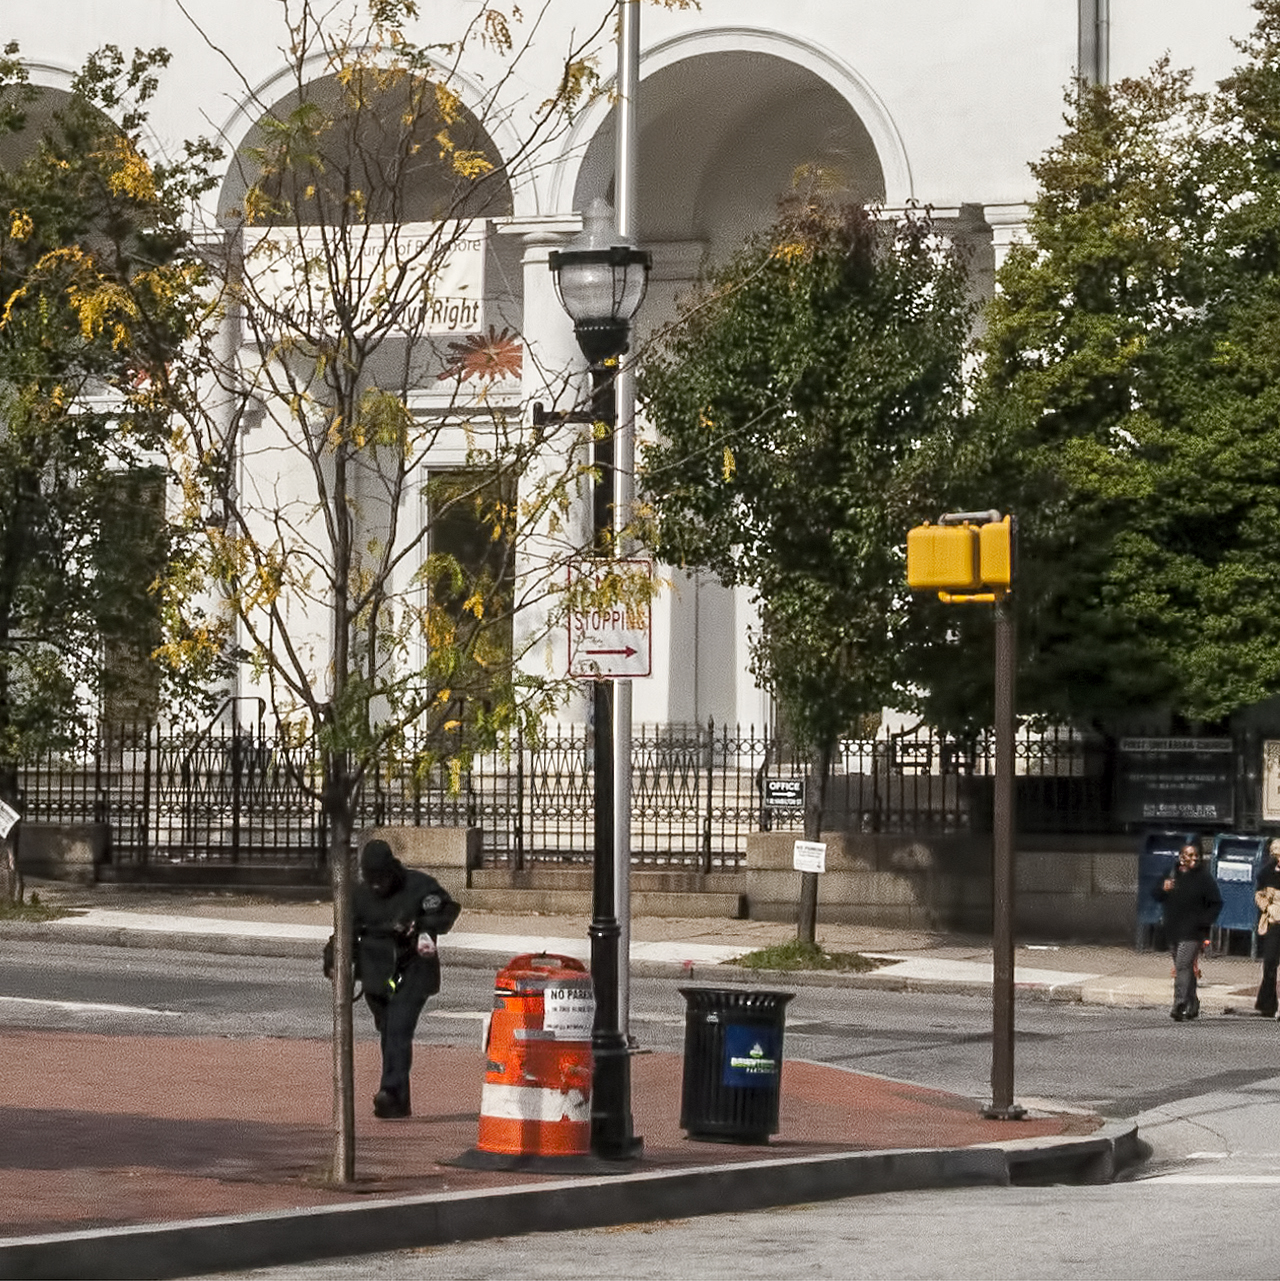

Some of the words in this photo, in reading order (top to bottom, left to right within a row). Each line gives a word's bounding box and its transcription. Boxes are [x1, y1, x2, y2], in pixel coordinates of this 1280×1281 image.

[399, 240, 412, 256] of
[431, 297, 480, 330] Right
[768, 781, 801, 791] OFFICE
[551, 989, 564, 1000] NO
